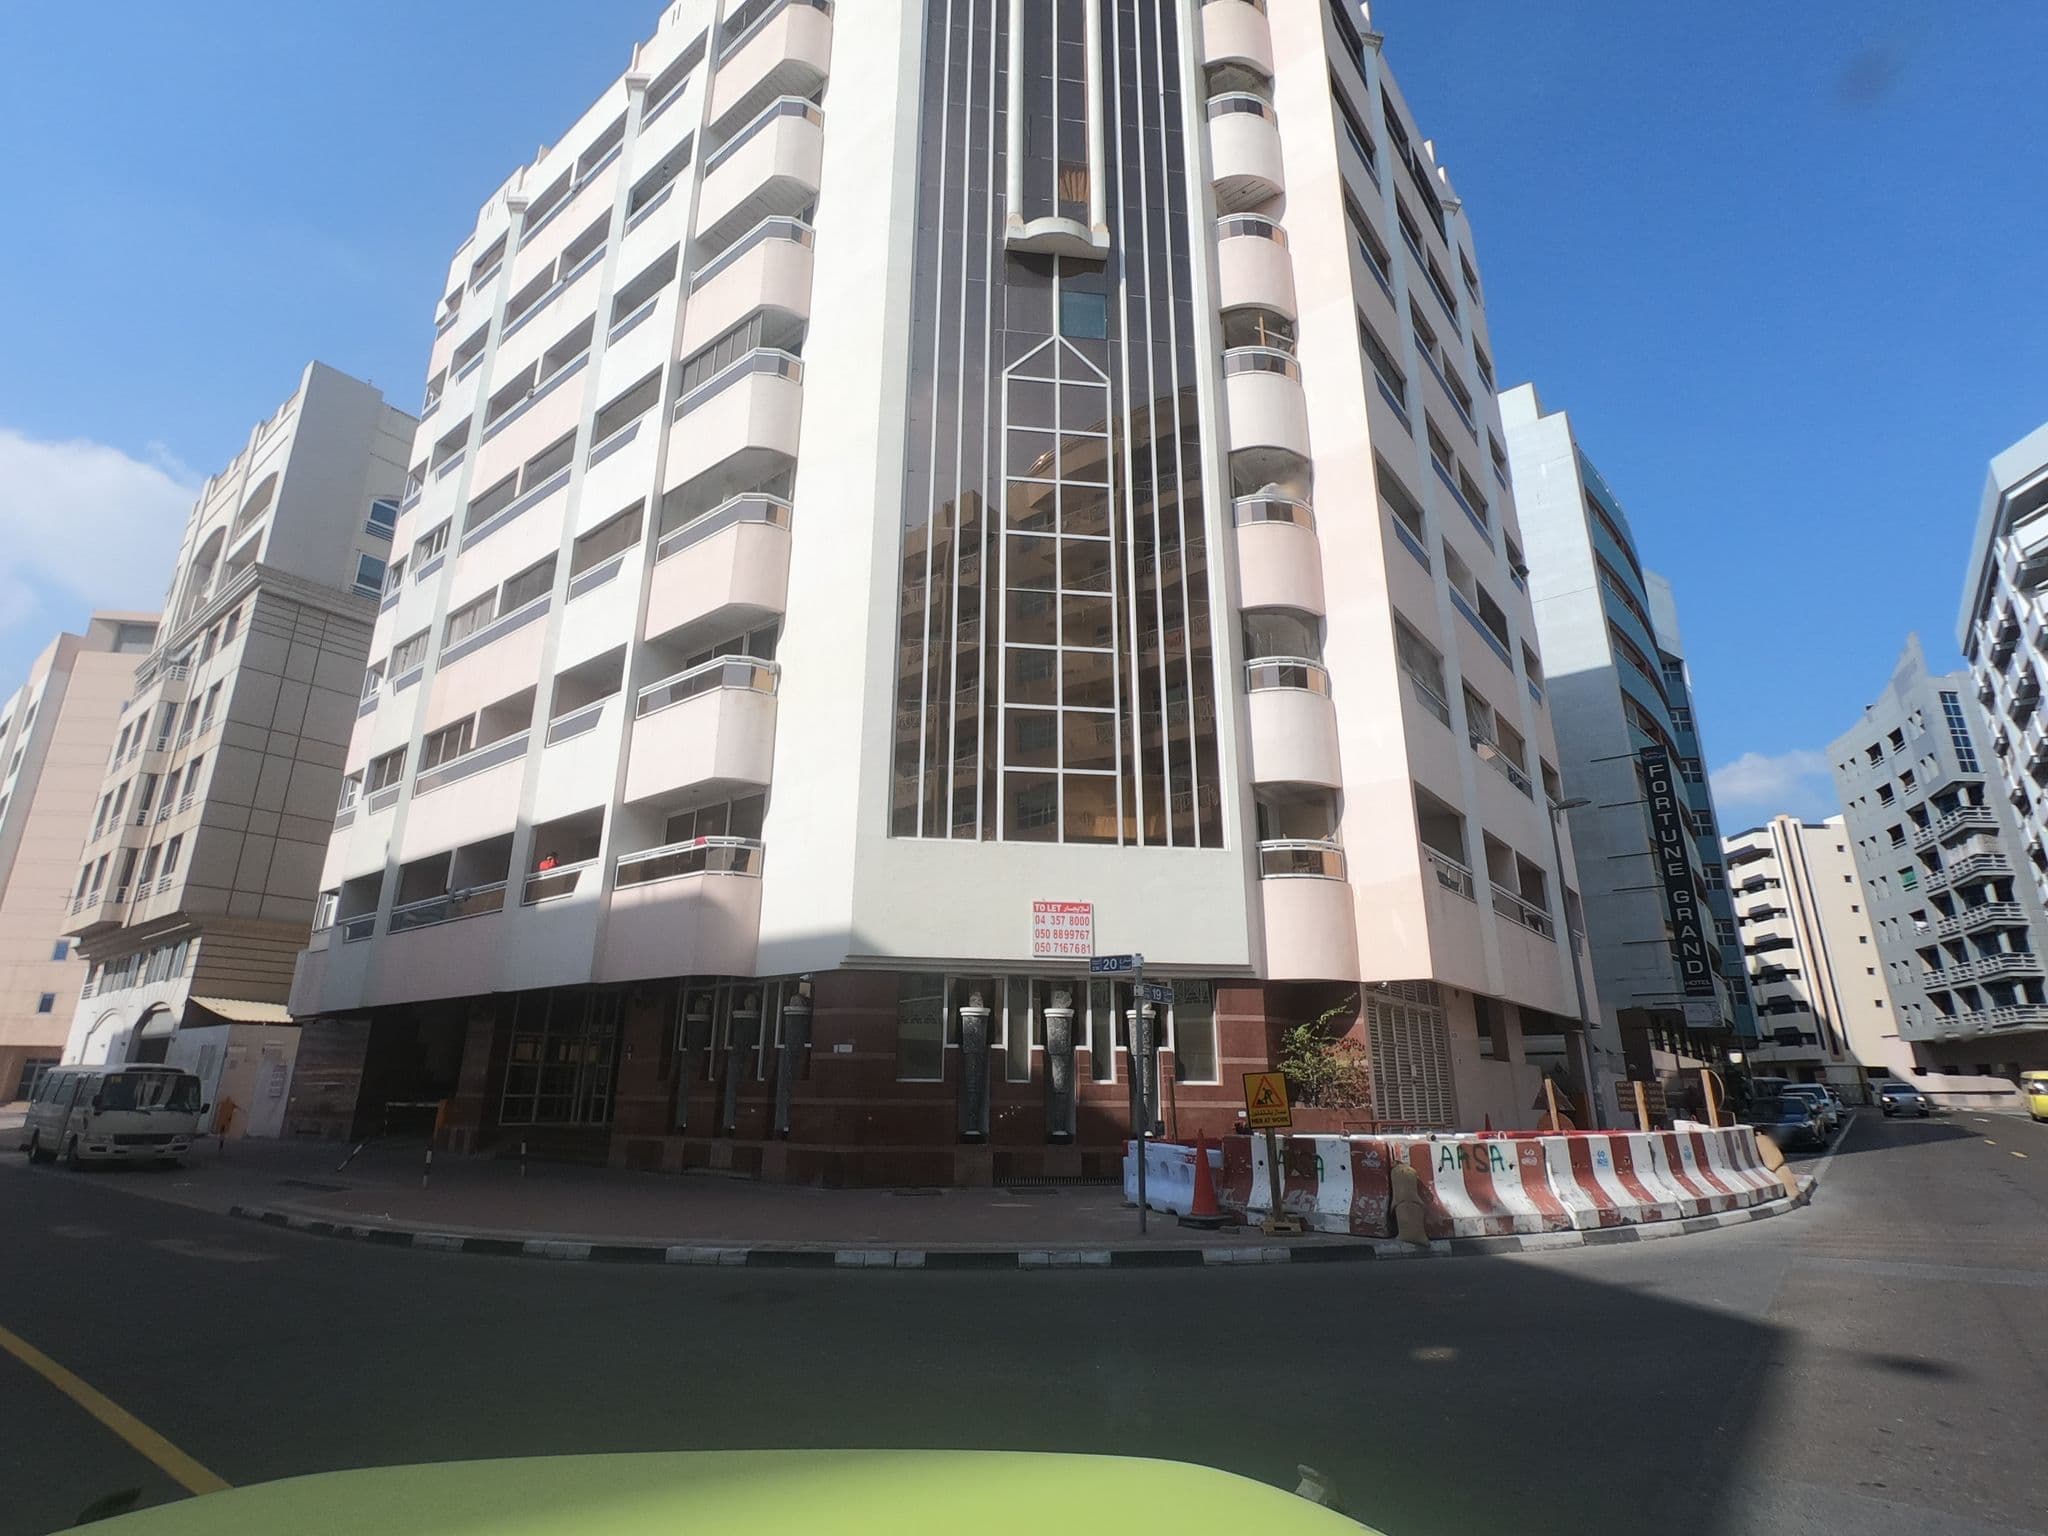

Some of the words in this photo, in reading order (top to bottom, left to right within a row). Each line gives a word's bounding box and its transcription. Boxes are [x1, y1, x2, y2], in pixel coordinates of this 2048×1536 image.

[1649, 764, 1685, 876] FORTUNE
[1673, 890, 1704, 974] GRAND
[1034, 903, 1046, 912] TO
[1046, 904, 1062, 912] LET
[1035, 915, 1046, 925] 04
[1050, 915, 1066, 925] 357
[1069, 916, 1090, 926] 8000
[1035, 929, 1051, 939] 050
[1053, 929, 1090, 940] 8899767
[1035, 942, 1051, 952] 050
[1053, 943, 1091, 954] 7167681
[1103, 958, 1118, 970] 20
[1152, 988, 1162, 1000] 19
